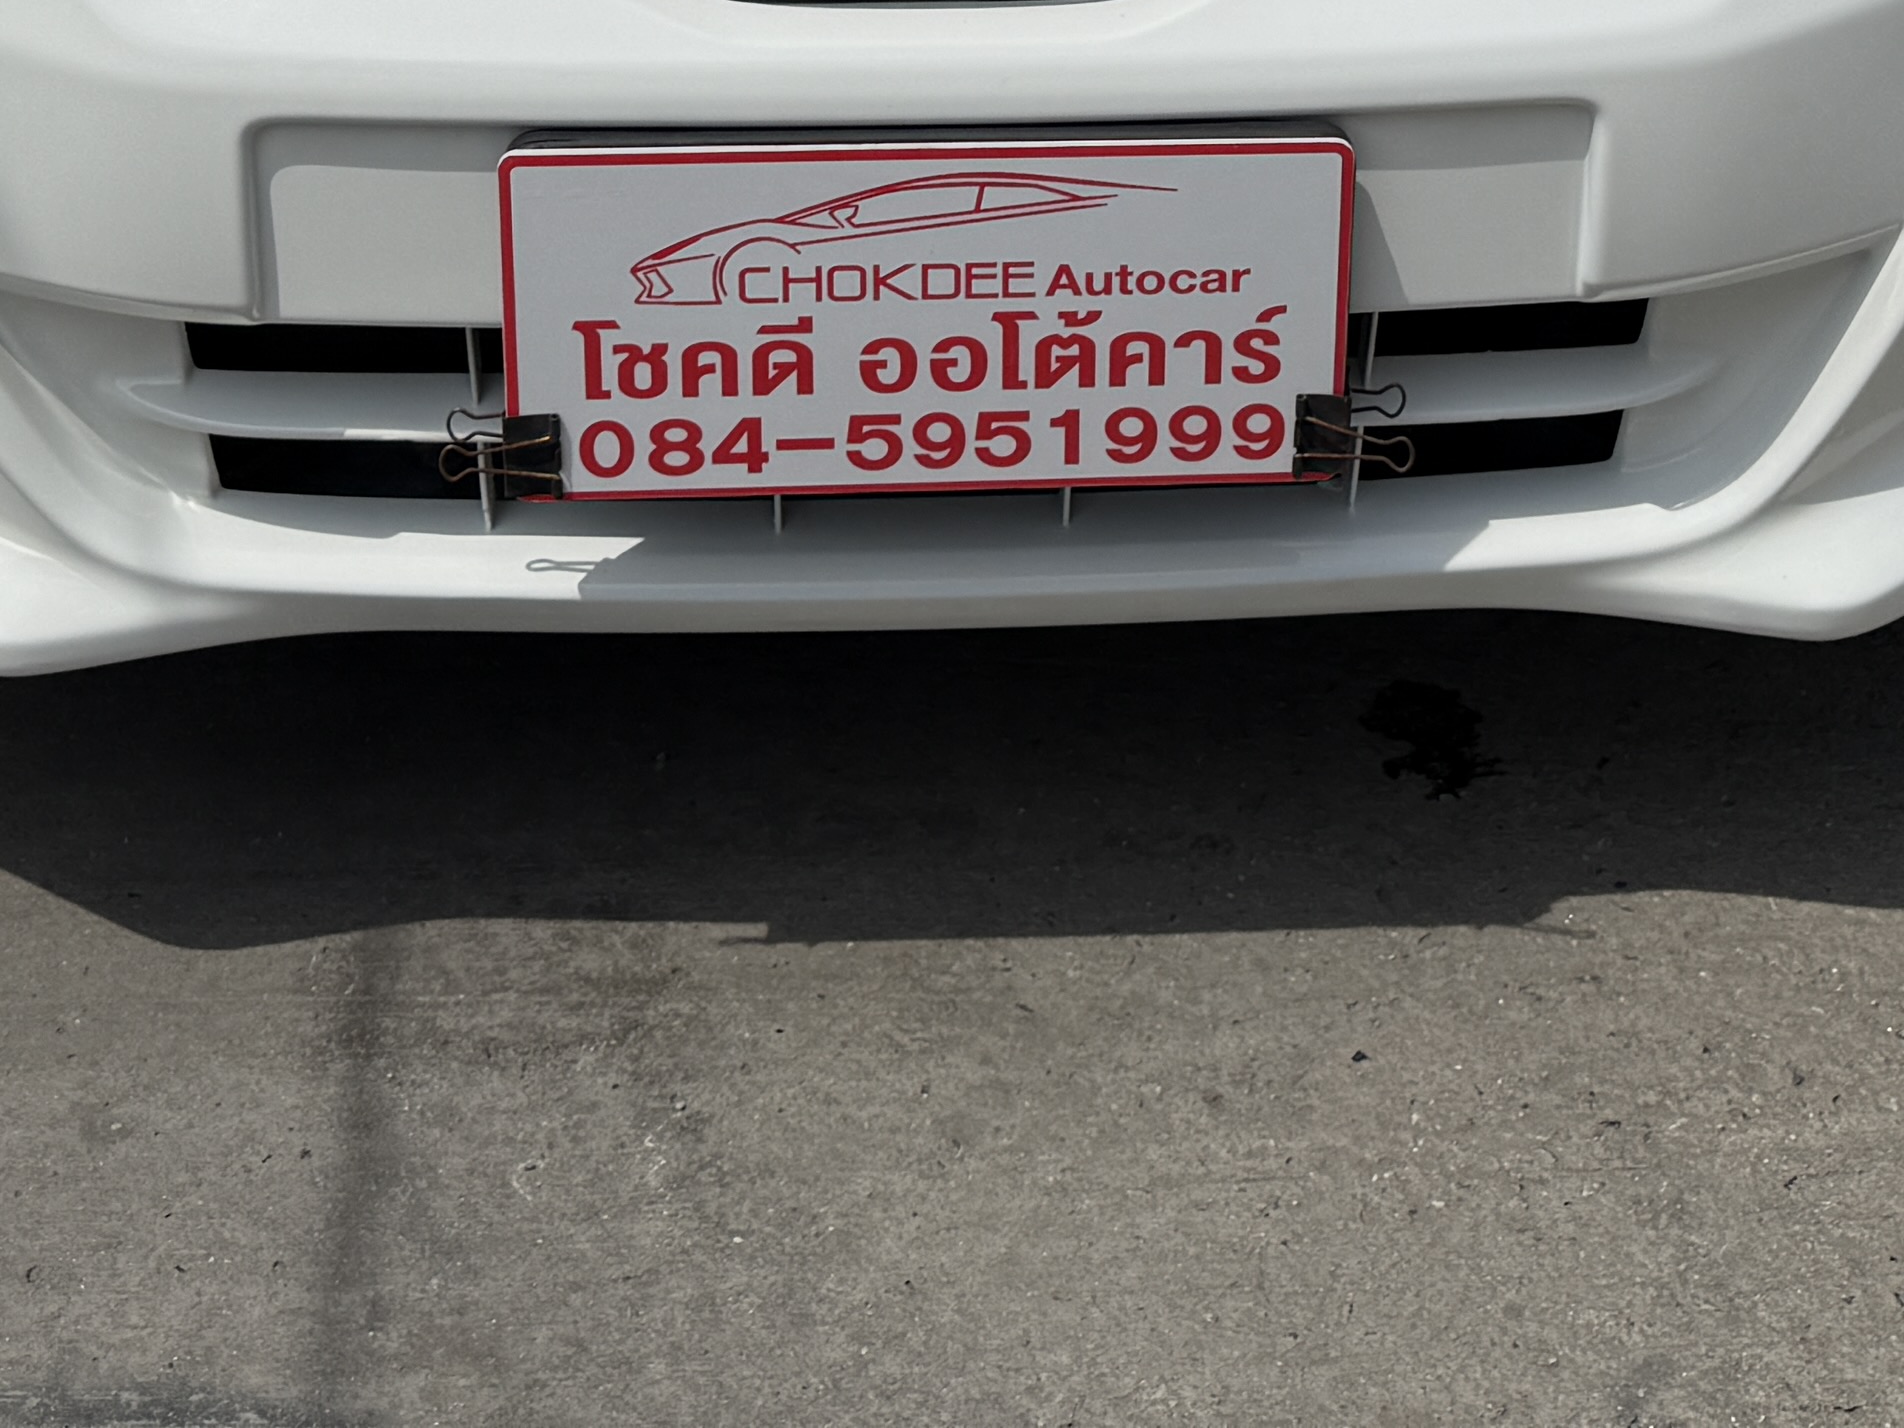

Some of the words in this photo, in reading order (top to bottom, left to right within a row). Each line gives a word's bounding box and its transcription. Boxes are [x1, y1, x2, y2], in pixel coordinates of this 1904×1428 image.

[737, 260, 1037, 304] CHOKDEE
[1044, 263, 1252, 297] Autocar
[570, 315, 815, 401] โชคดี
[858, 303, 1288, 394] ออโต้คาร์
[578, 402, 1286, 479] 084-5951999
